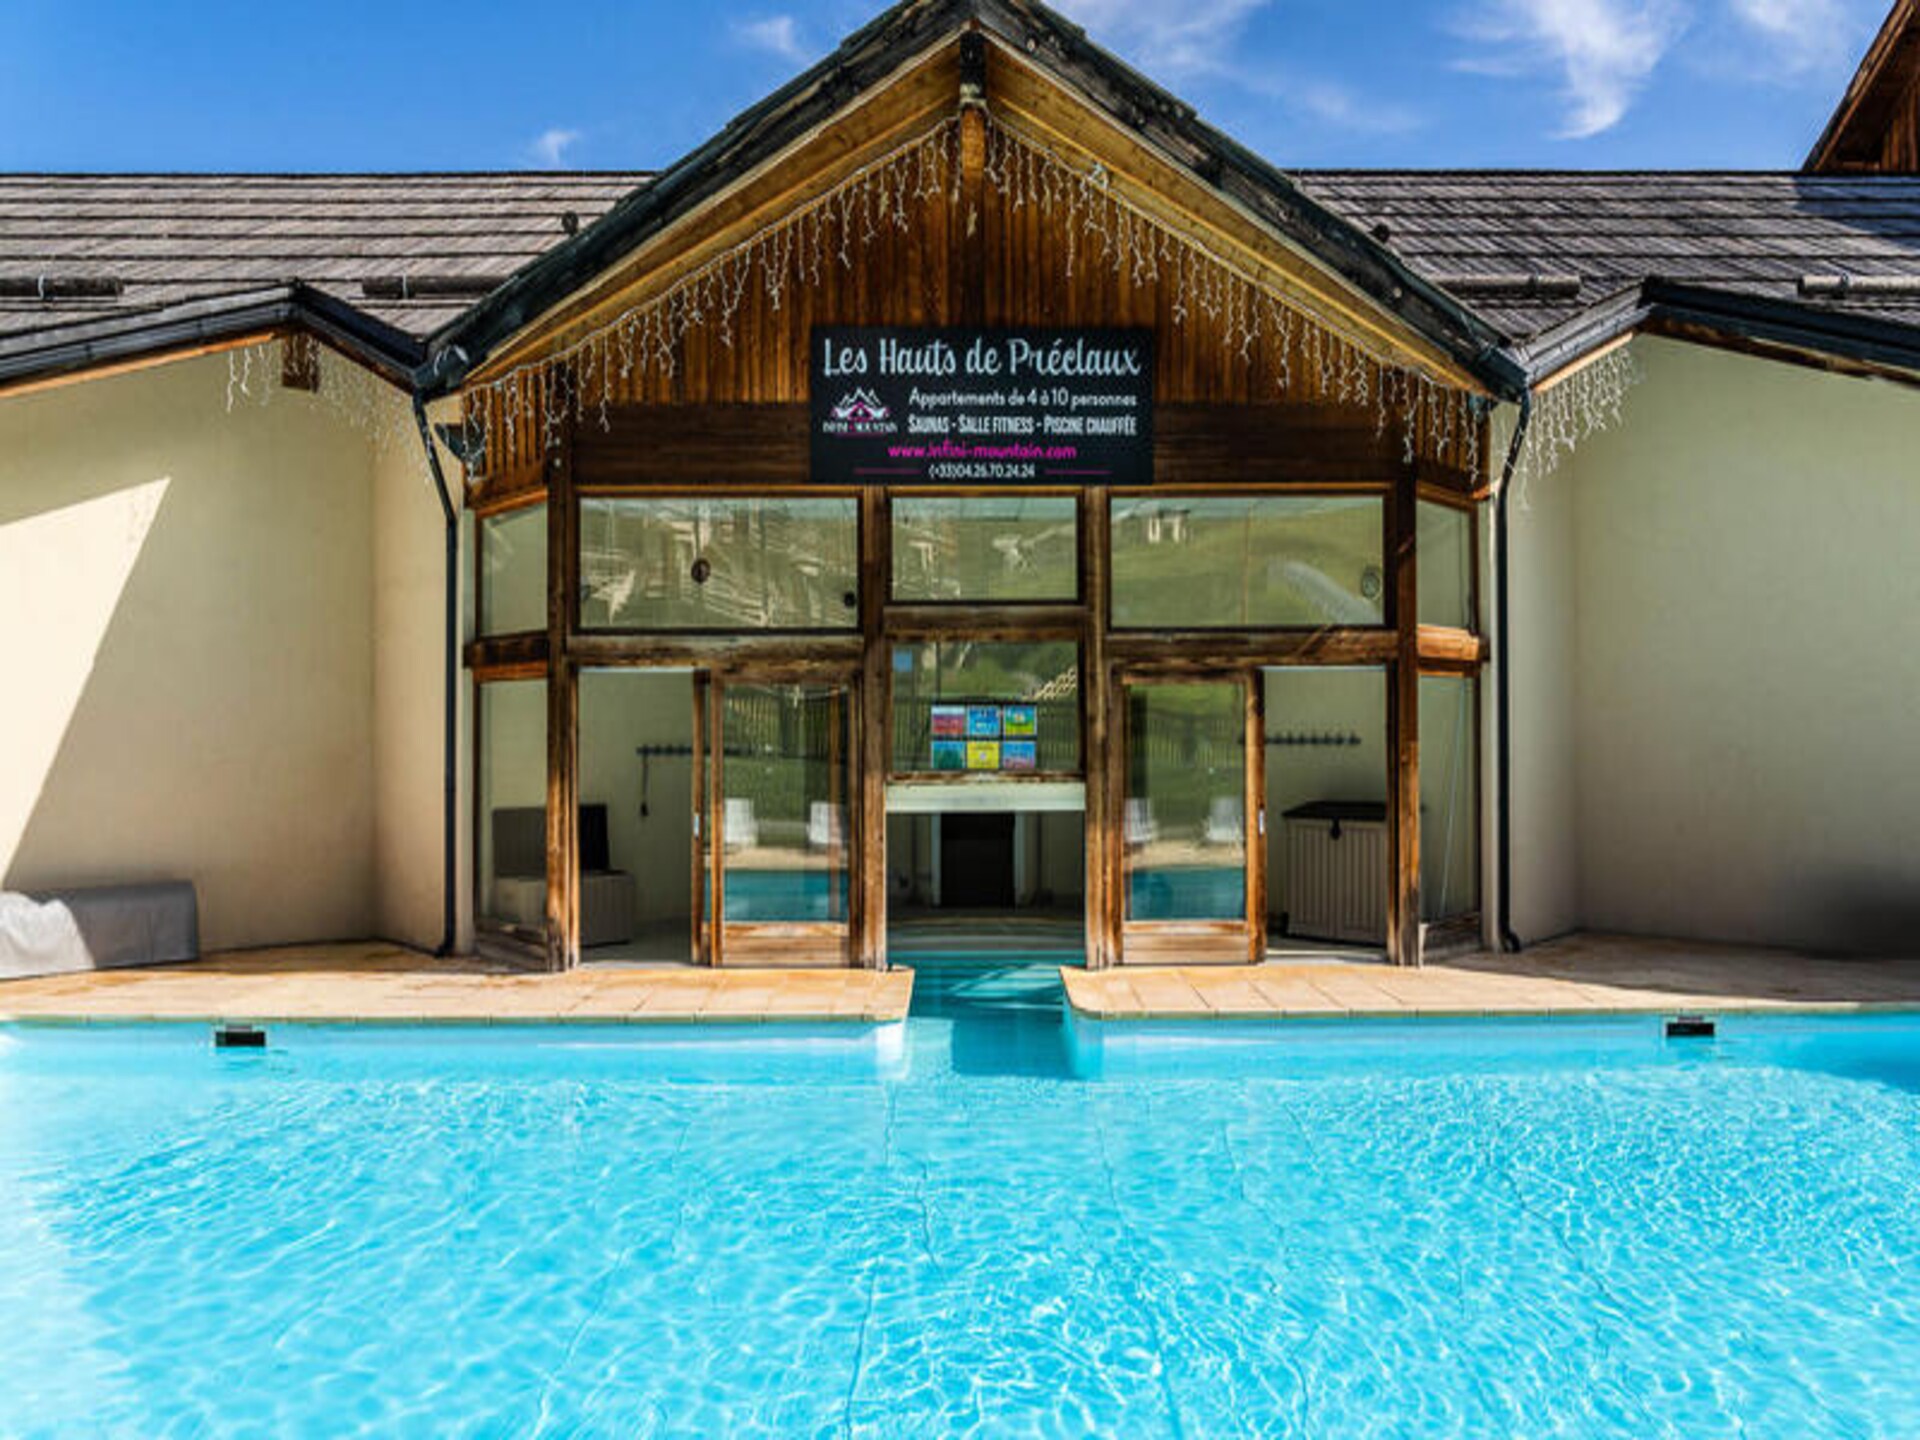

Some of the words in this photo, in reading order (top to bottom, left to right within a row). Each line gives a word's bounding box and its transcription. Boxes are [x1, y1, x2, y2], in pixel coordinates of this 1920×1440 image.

[824, 338, 868, 376] Les
[879, 338, 957, 376] Hauts
[965, 337, 1002, 375] de
[908, 388, 1005, 409] Appartements
[1008, 388, 1025, 406] de
[1027, 388, 1037, 405] 4
[1040, 389, 1049, 406] à
[1053, 388, 1069, 405] 10
[1071, 393, 1137, 411] personnes
[887, 439, 1077, 459] www.infini-mountain.com
